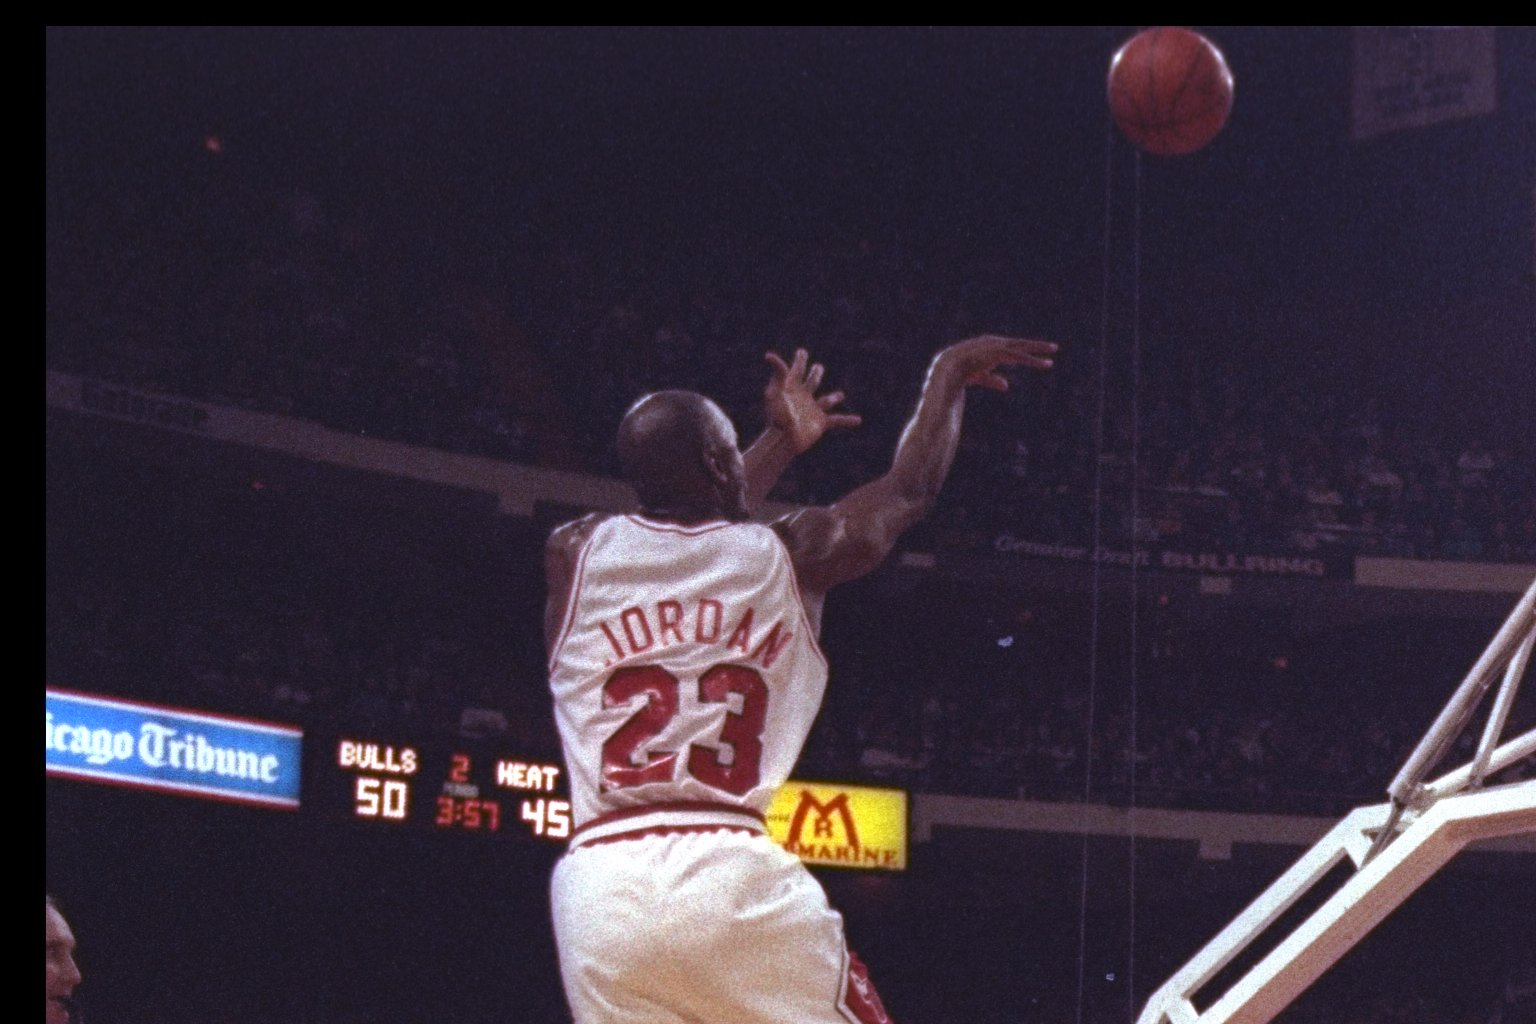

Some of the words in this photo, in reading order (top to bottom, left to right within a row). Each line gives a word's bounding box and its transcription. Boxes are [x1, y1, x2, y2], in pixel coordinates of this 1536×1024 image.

[1161, 549, 1325, 576] BULLRING
[600, 598, 794, 669] JORDAN
[600, 663, 770, 797] 23
[138, 722, 279, 784] Tribune
[339, 741, 417, 773] BULLS
[452, 754, 470, 783] 2
[497, 761, 560, 791] HEAT
[356, 776, 408, 819] 50
[436, 796, 499, 831] 3:57
[521, 799, 570, 838] 45
